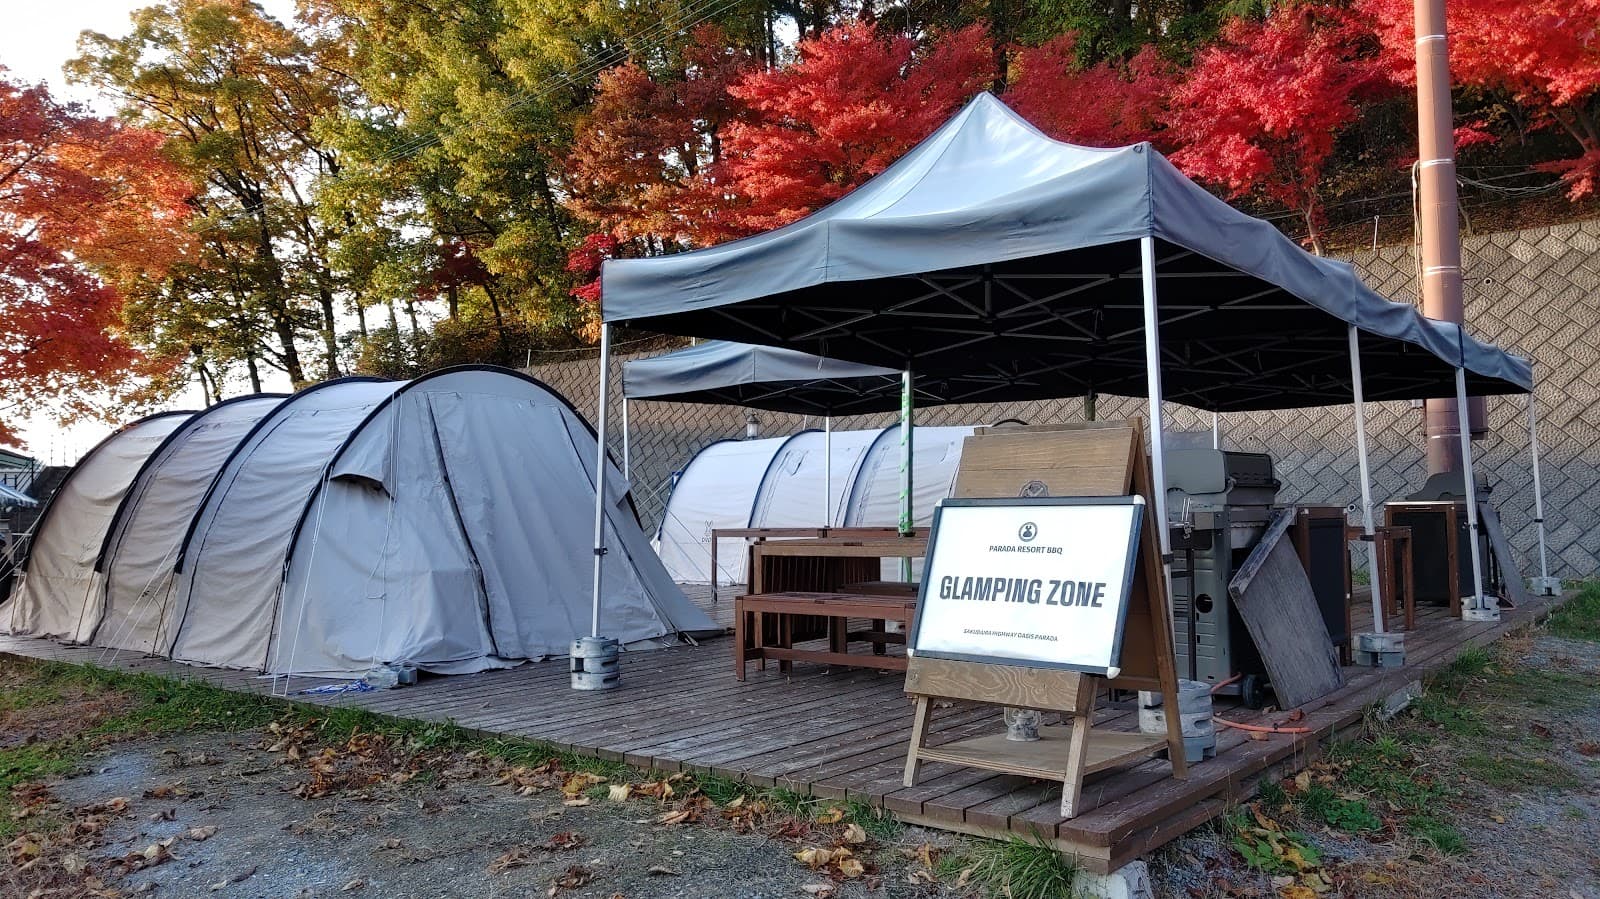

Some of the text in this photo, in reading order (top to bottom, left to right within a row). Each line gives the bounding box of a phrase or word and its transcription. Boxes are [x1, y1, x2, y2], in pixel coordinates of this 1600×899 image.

[1046, 547, 1063, 555] BBQ
[939, 575, 1106, 607] GLAMPING ZONE
[1017, 632, 1034, 640] OASIS
[1034, 634, 1058, 642] PARADA
